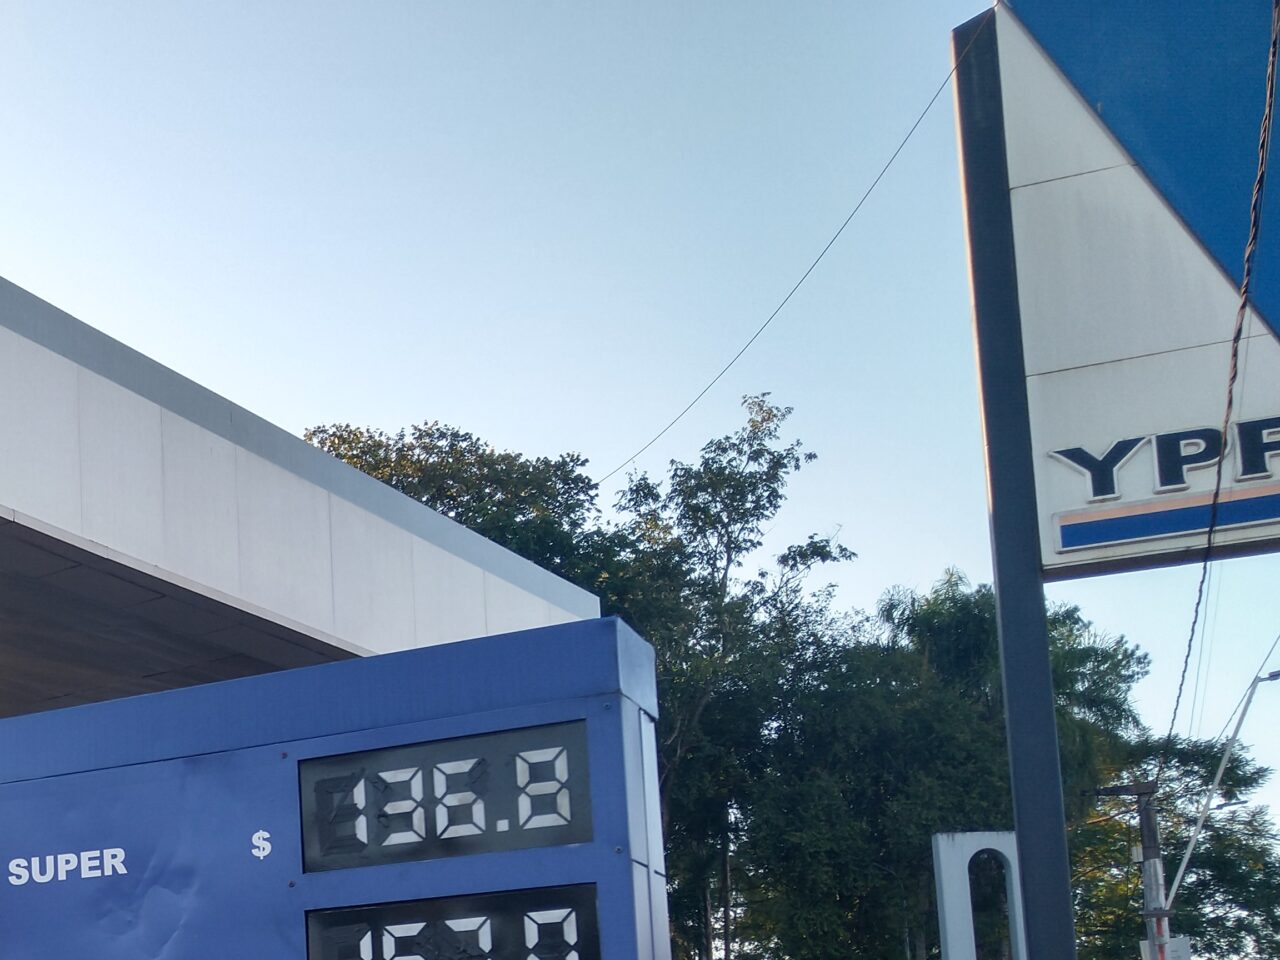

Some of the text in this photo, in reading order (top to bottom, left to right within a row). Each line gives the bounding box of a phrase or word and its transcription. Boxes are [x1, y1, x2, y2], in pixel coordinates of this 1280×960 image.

[1047, 417, 1280, 503] YPF
[7, 746, 571, 885] SUPER $ 136.8
